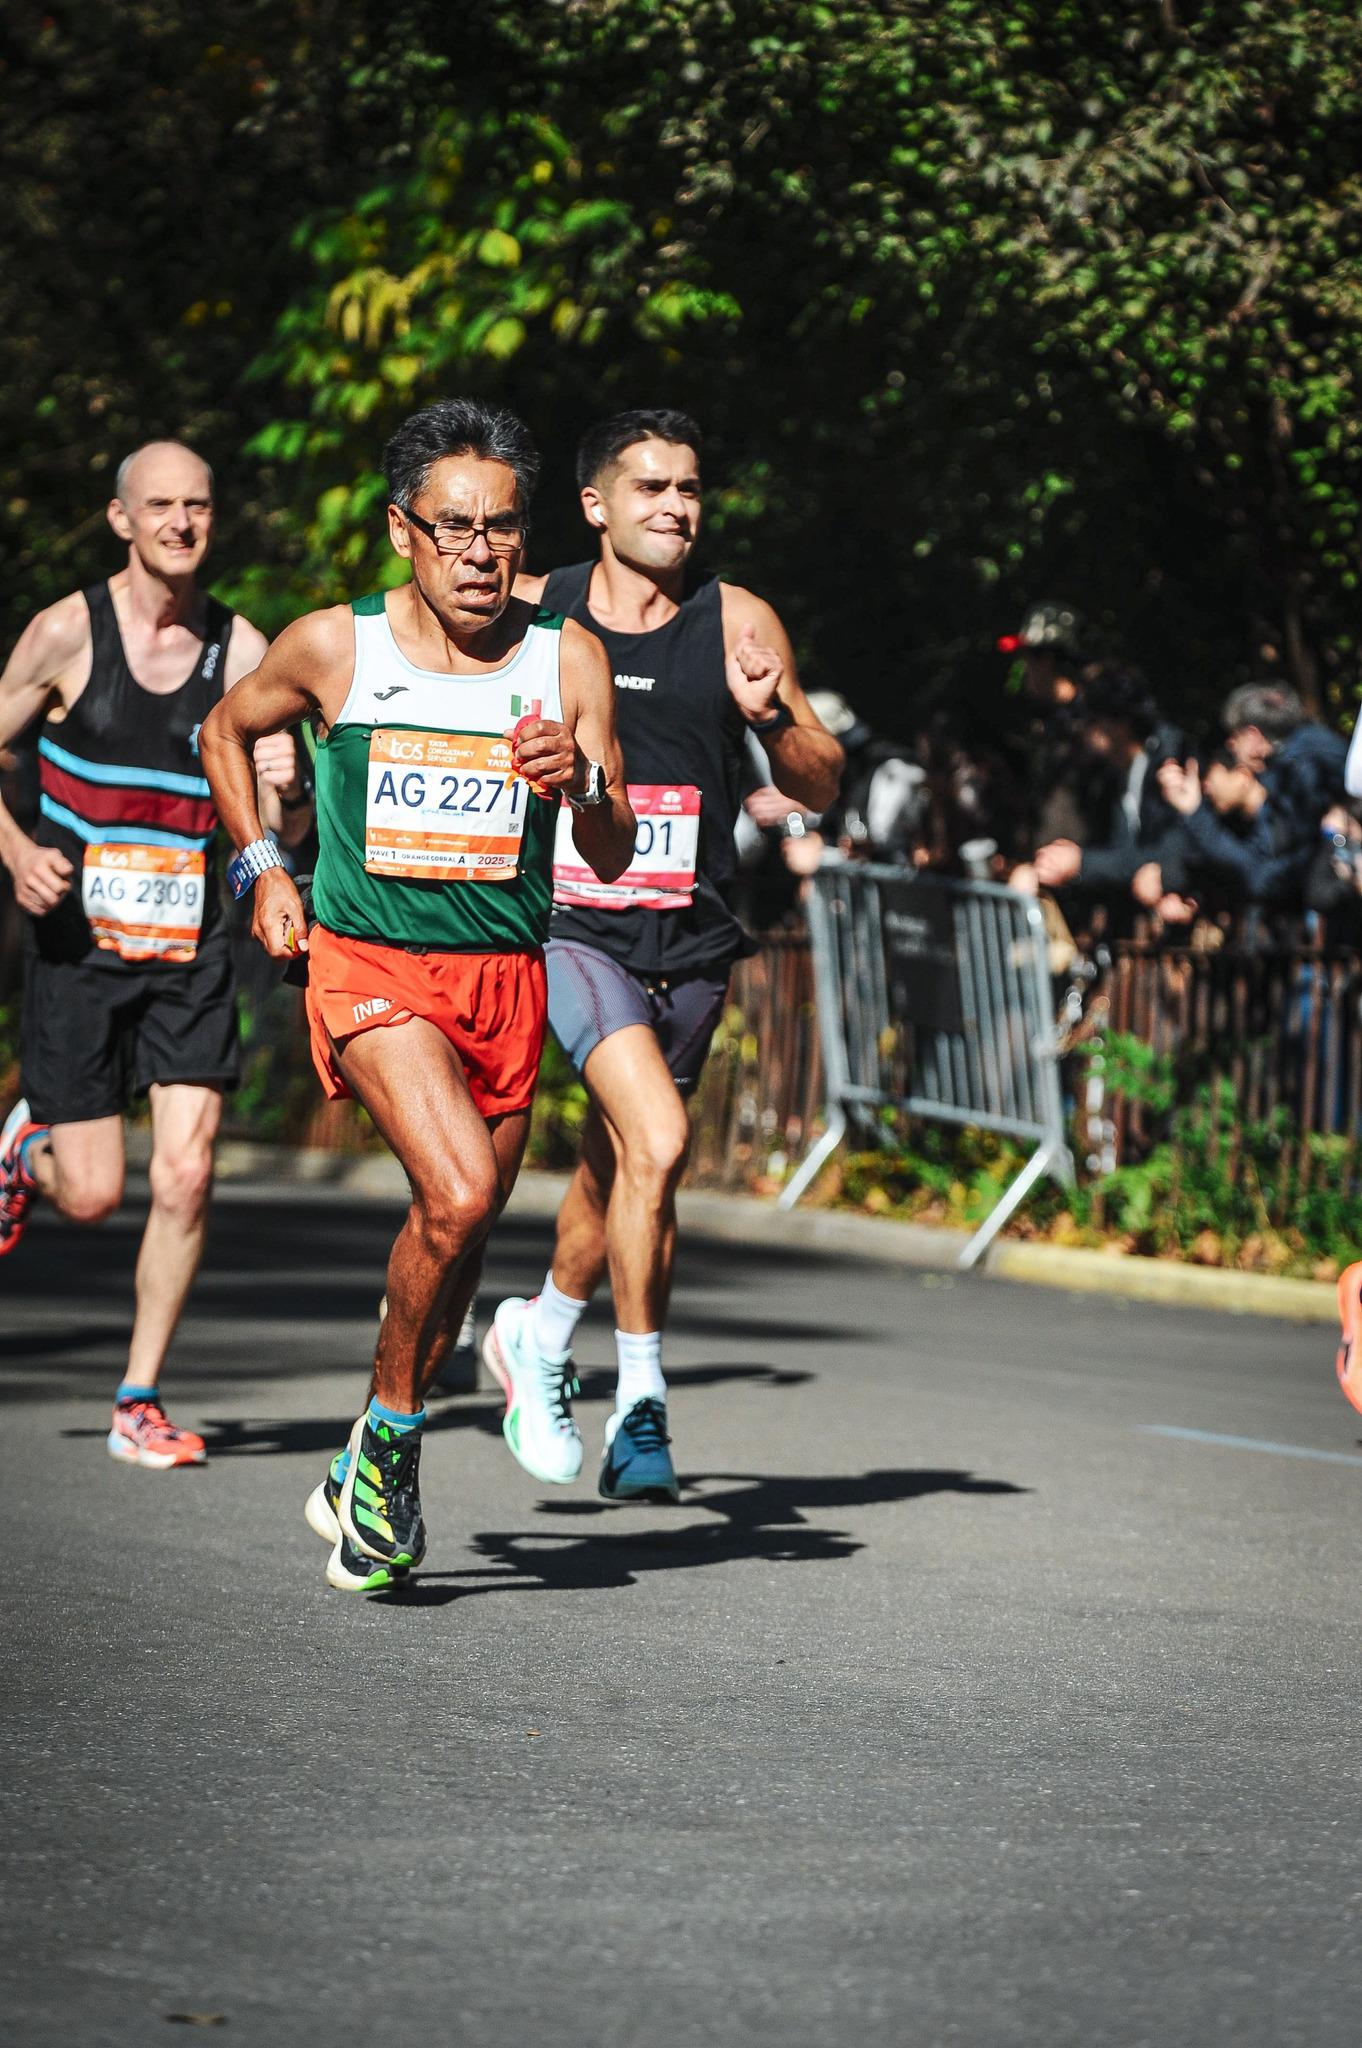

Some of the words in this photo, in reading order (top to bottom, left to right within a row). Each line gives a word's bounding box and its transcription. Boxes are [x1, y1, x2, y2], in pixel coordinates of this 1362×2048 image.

[389, 737, 424, 760] tcs
[427, 755, 458, 763] SERVICES
[486, 759, 512, 768] TATA
[374, 771, 426, 807] AG
[438, 776, 520, 814] 2271
[635, 820, 672, 856] 01
[369, 849, 389, 857] WAVE
[391, 851, 396, 859] 1
[401, 853, 429, 861] ORANGE
[431, 855, 456, 863] CORRAL
[458, 855, 465, 864] A
[478, 856, 505, 865] 2025
[89, 876, 125, 901] AG
[136, 879, 198, 906] 2309
